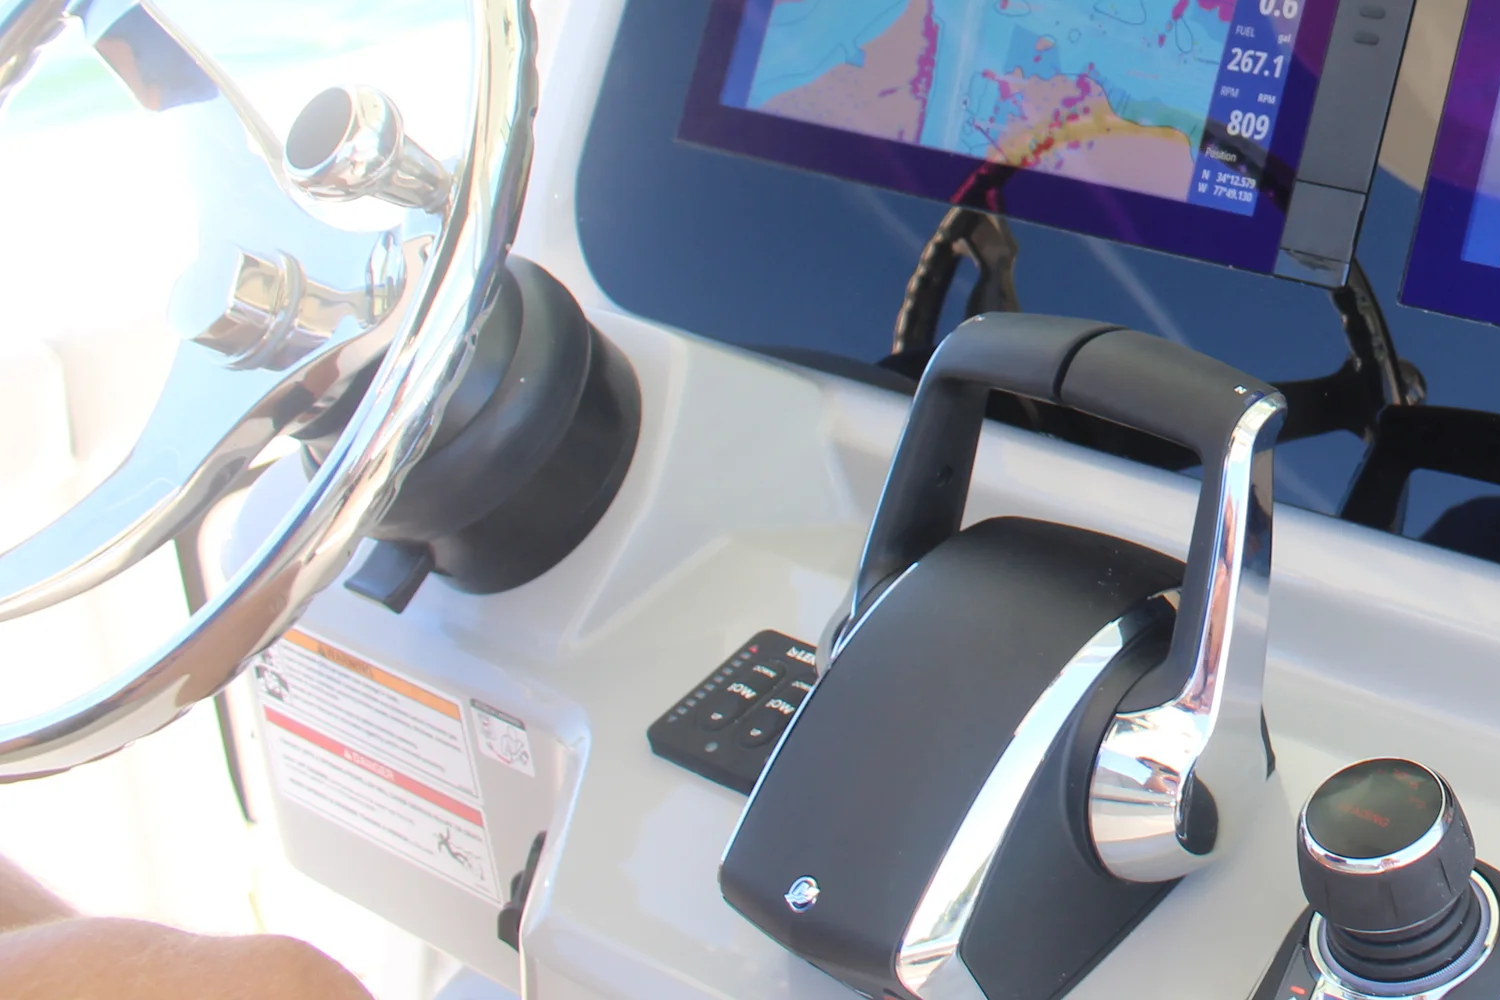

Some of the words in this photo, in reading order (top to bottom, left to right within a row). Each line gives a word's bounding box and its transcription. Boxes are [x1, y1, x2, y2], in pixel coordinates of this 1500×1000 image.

[1235, 24, 1255, 38] FUEL
[1277, 33, 1292, 45] gal
[1227, 48, 1284, 79] 267.1
[1220, 85, 1240, 98] RPM
[1257, 92, 1276, 105] RPM
[1226, 109, 1270, 141] 809
[1205, 146, 1237, 163] Position
[1201, 169, 1211, 180] N
[1198, 182, 1208, 194] W
